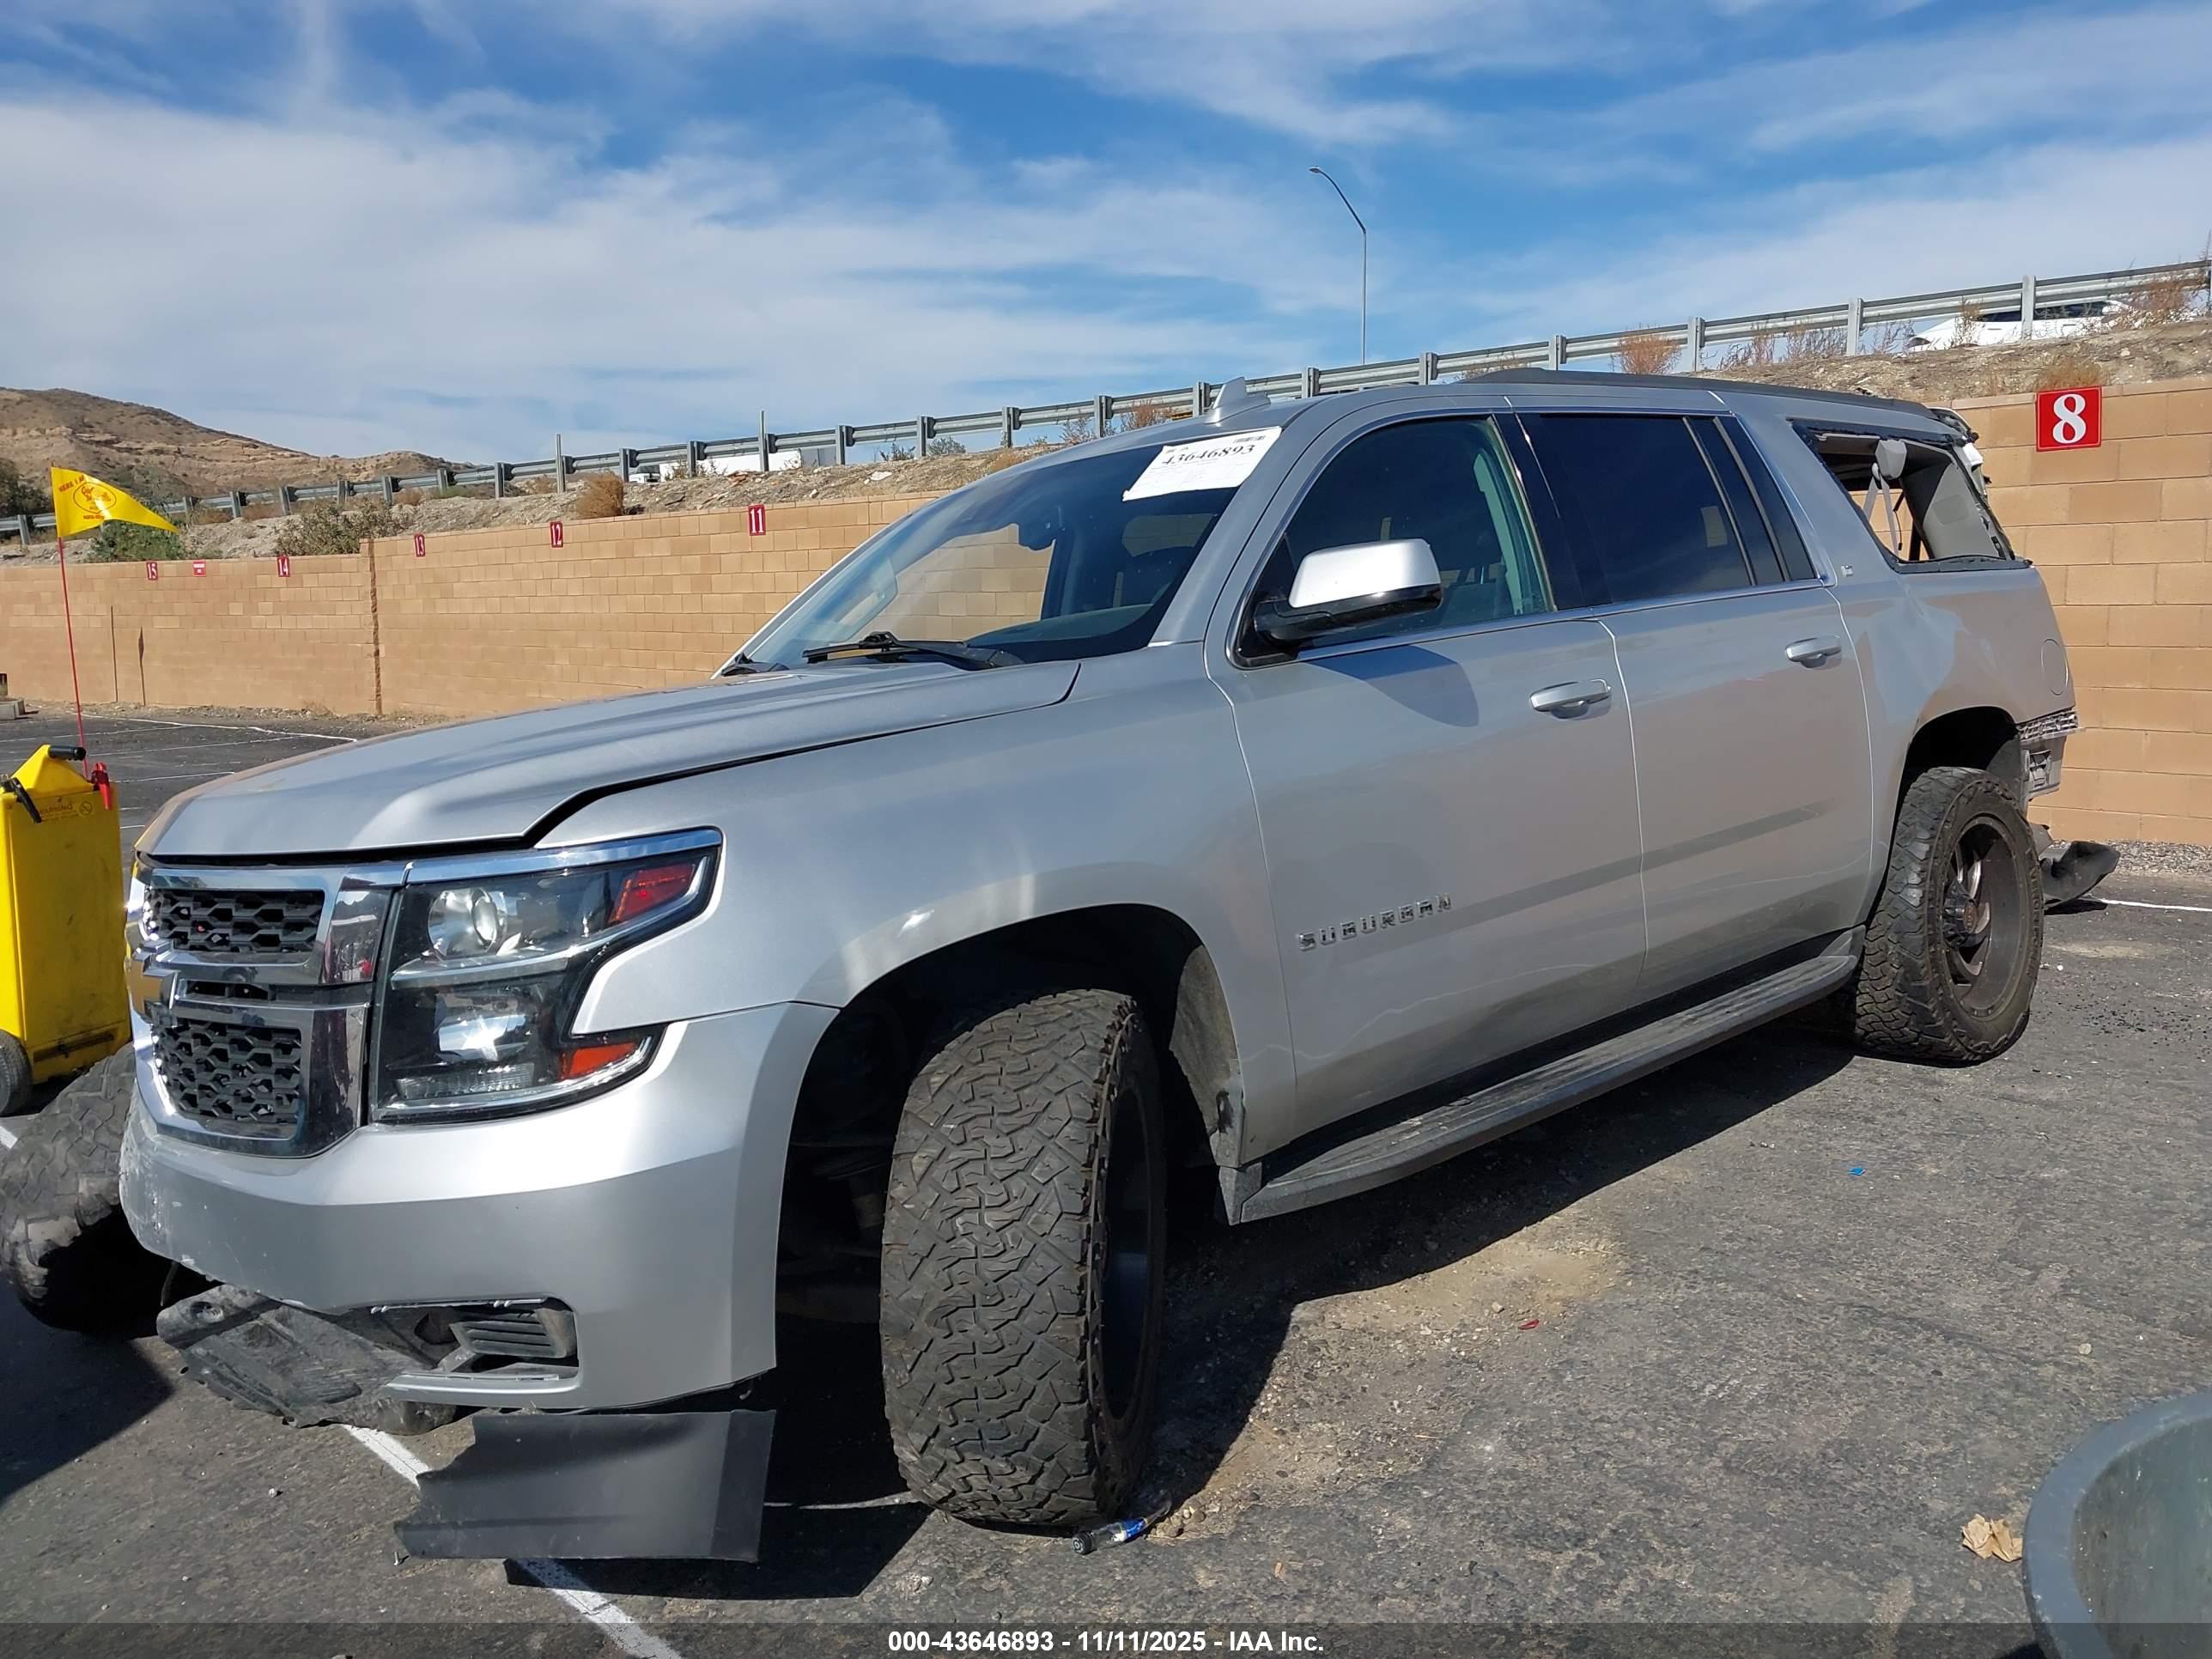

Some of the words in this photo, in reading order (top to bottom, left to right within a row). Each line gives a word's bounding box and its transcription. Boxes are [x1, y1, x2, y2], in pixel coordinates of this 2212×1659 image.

[2052, 393, 2087, 444] 8
[1161, 443, 1256, 465] 43646893
[750, 507, 764, 533] 11
[415, 535, 425, 556] 13
[550, 523, 562, 546] 12
[147, 562, 157, 580] 15
[278, 557, 289, 576] 14
[1297, 892, 1452, 951] SUBURBAN
